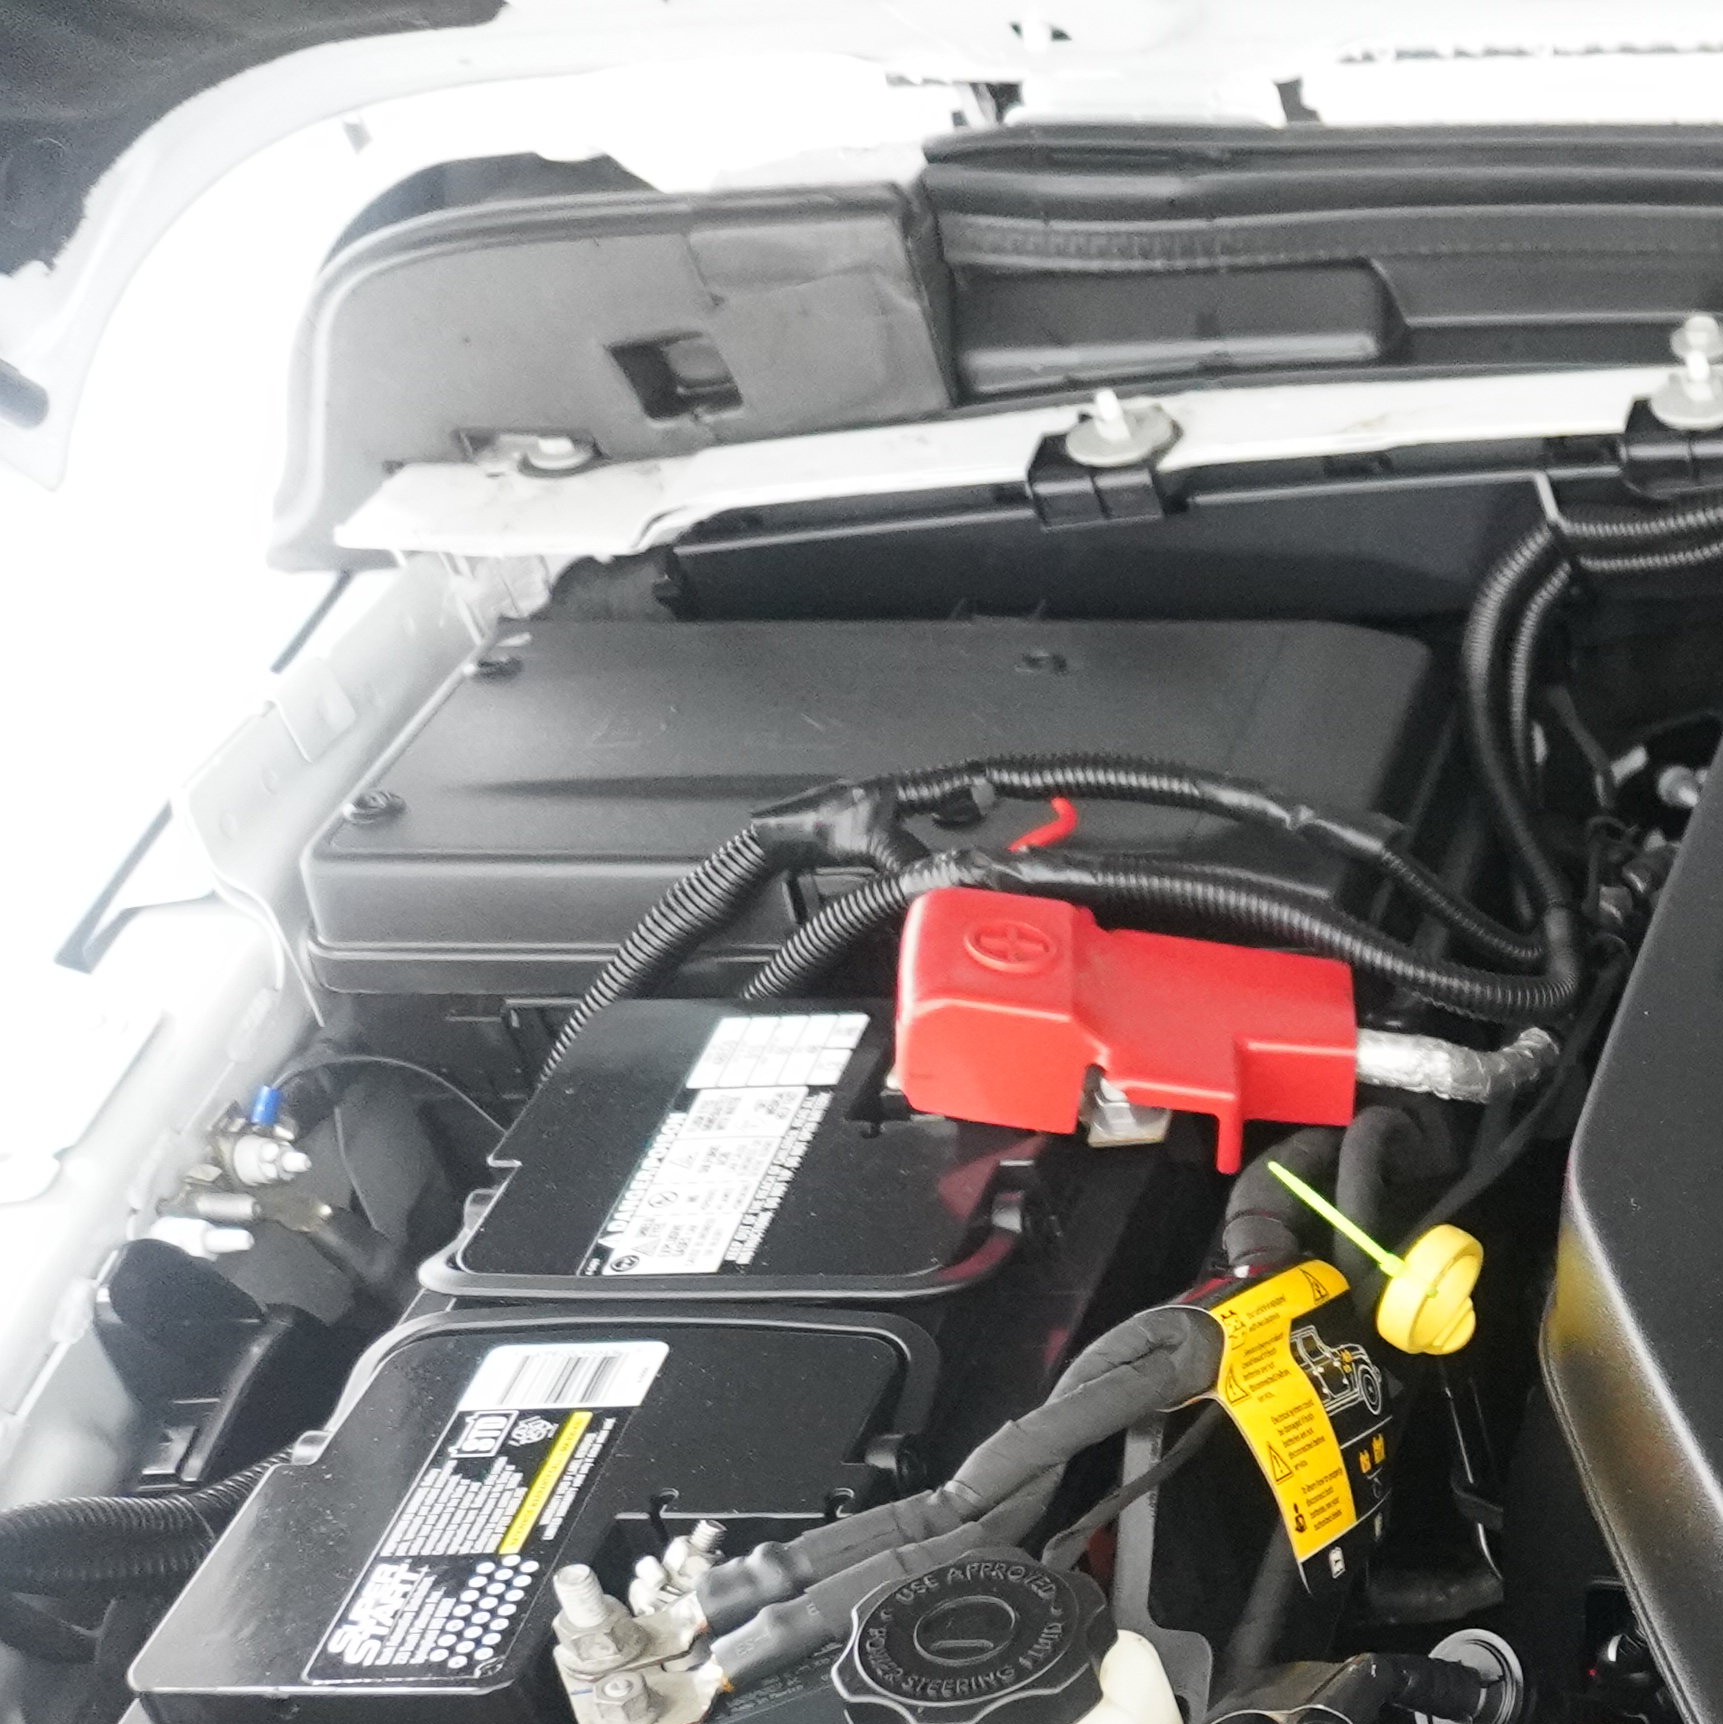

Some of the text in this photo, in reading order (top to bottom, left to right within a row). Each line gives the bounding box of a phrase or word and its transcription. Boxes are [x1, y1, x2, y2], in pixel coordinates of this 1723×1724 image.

[327, 1563, 410, 1653] SUPER
[344, 1568, 430, 1665] START
[895, 1575, 940, 1603] USE
[901, 1662, 1018, 1699] STEERING
